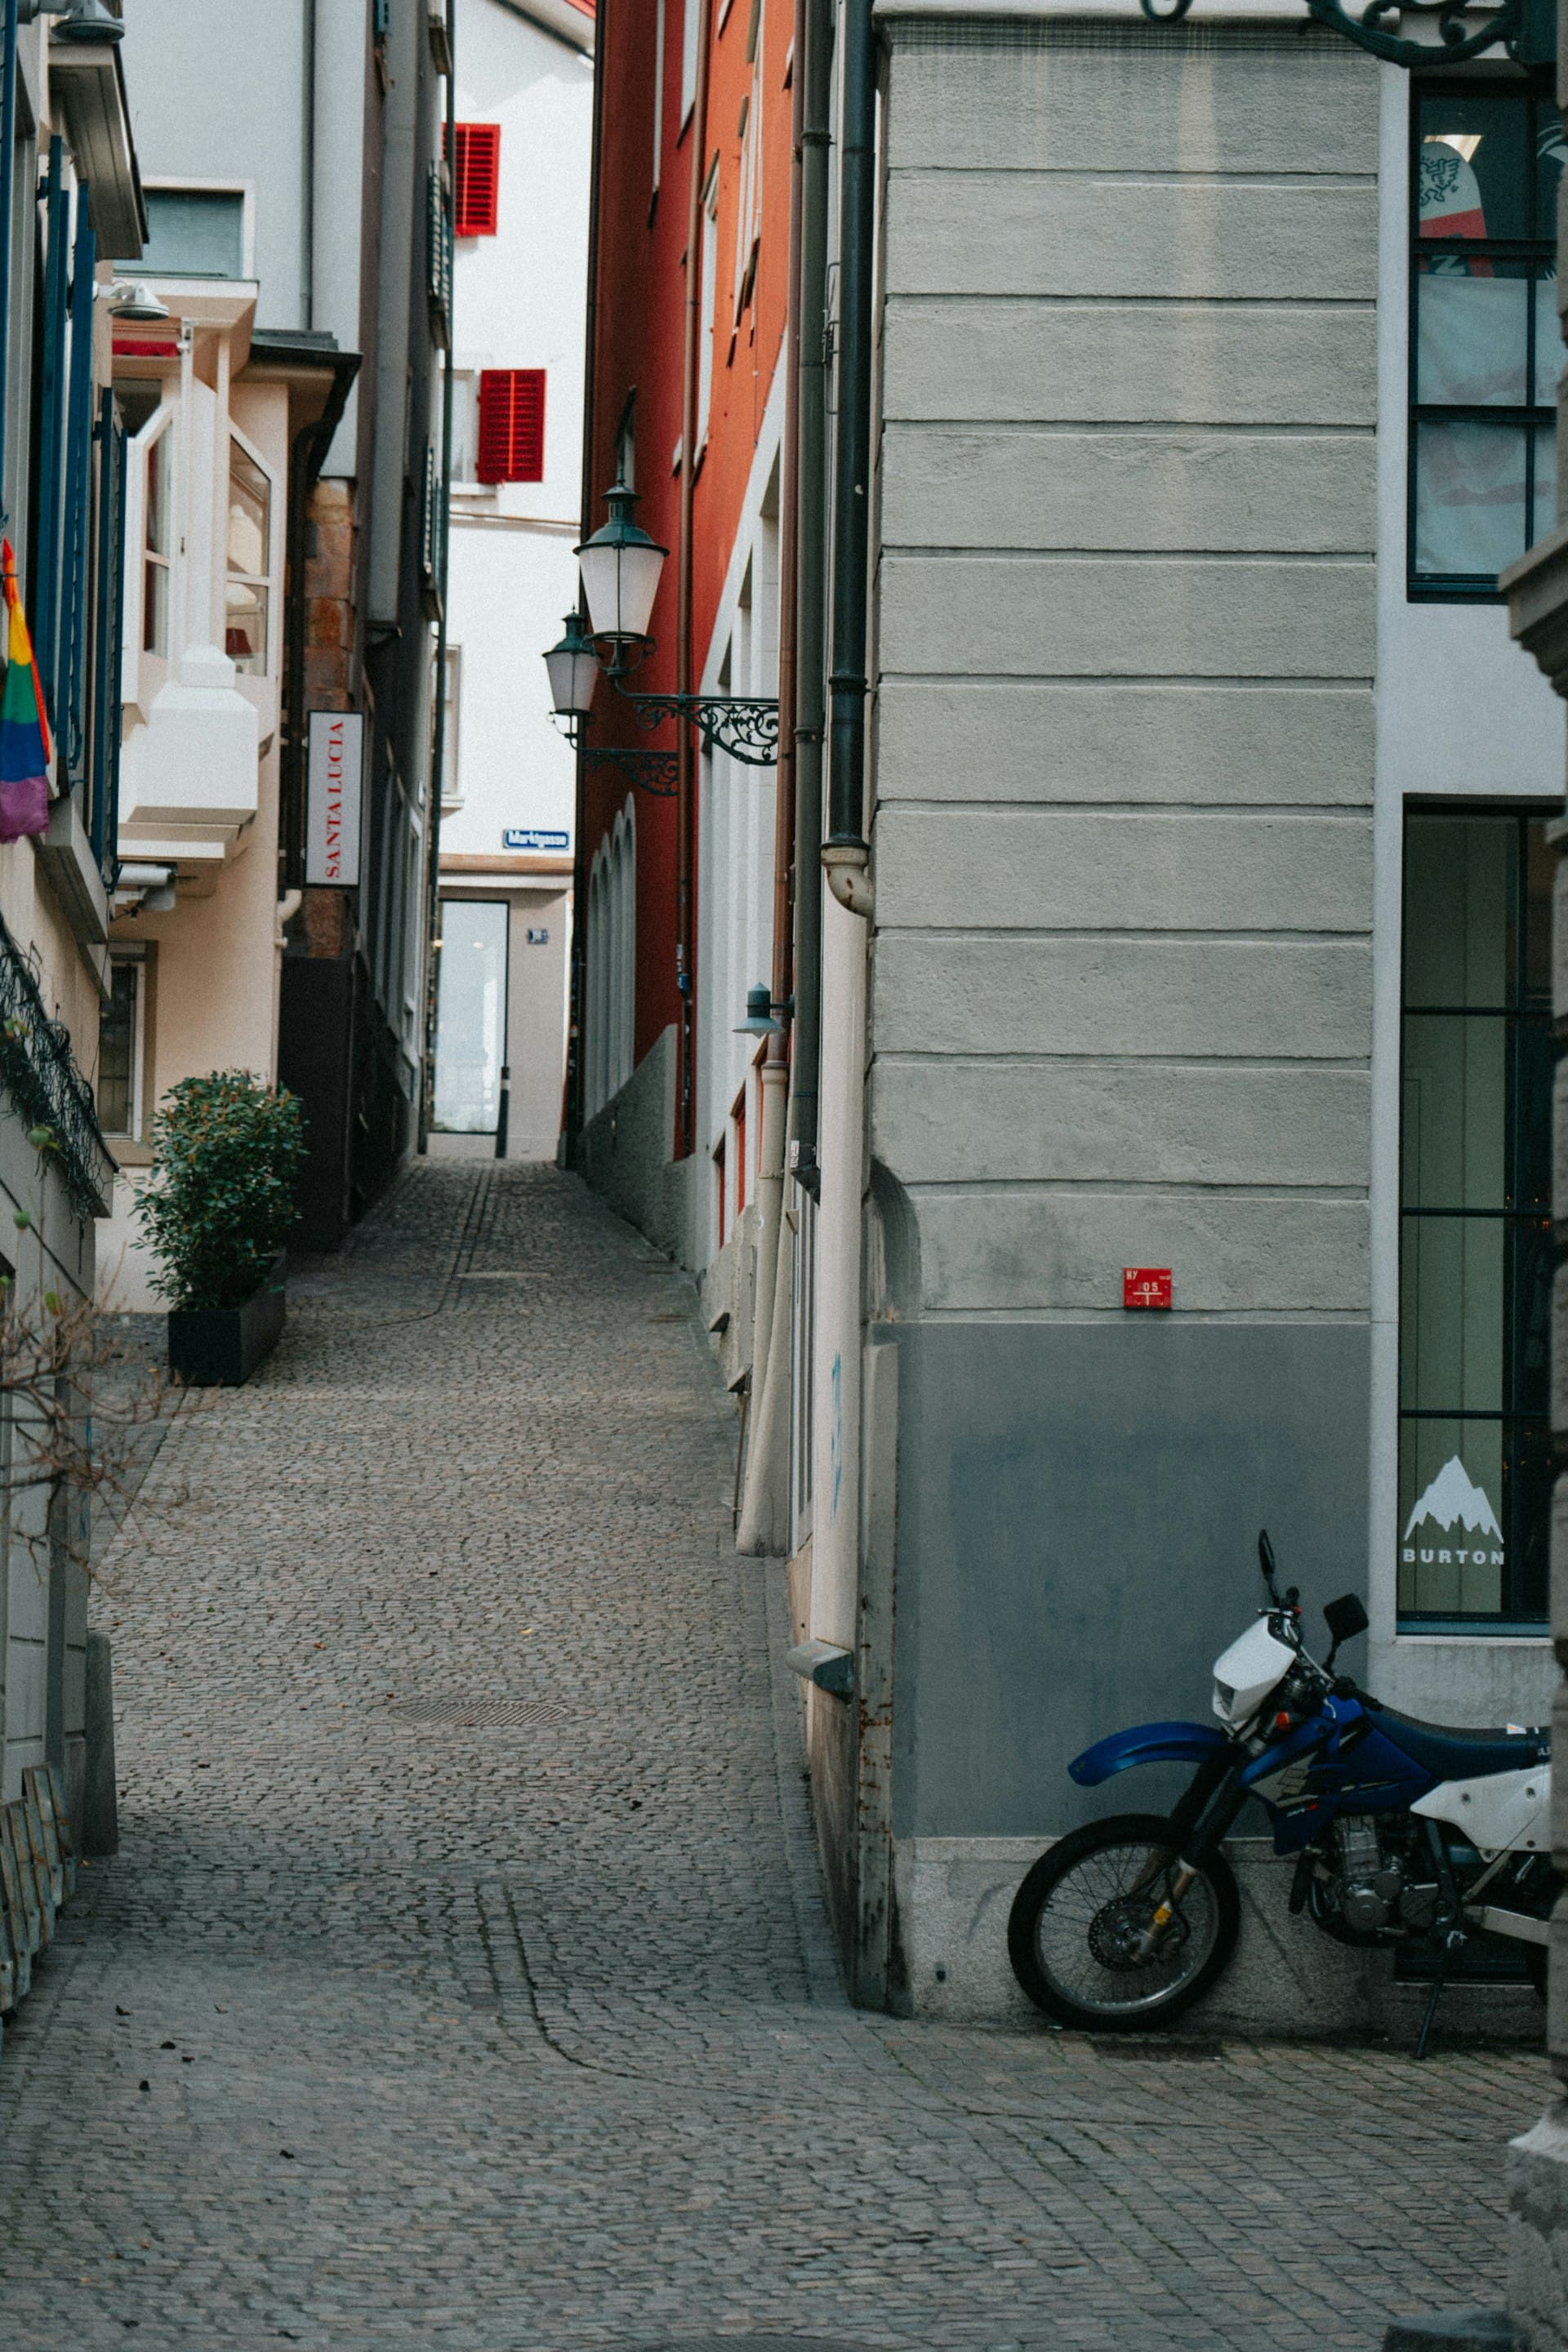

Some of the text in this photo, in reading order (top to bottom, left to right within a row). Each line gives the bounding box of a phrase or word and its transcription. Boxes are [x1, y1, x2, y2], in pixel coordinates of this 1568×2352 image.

[326, 721, 344, 879] SANTA LUCIA
[1143, 1281, 1159, 1292] 05
[1402, 1548, 1504, 1565] BURTON
